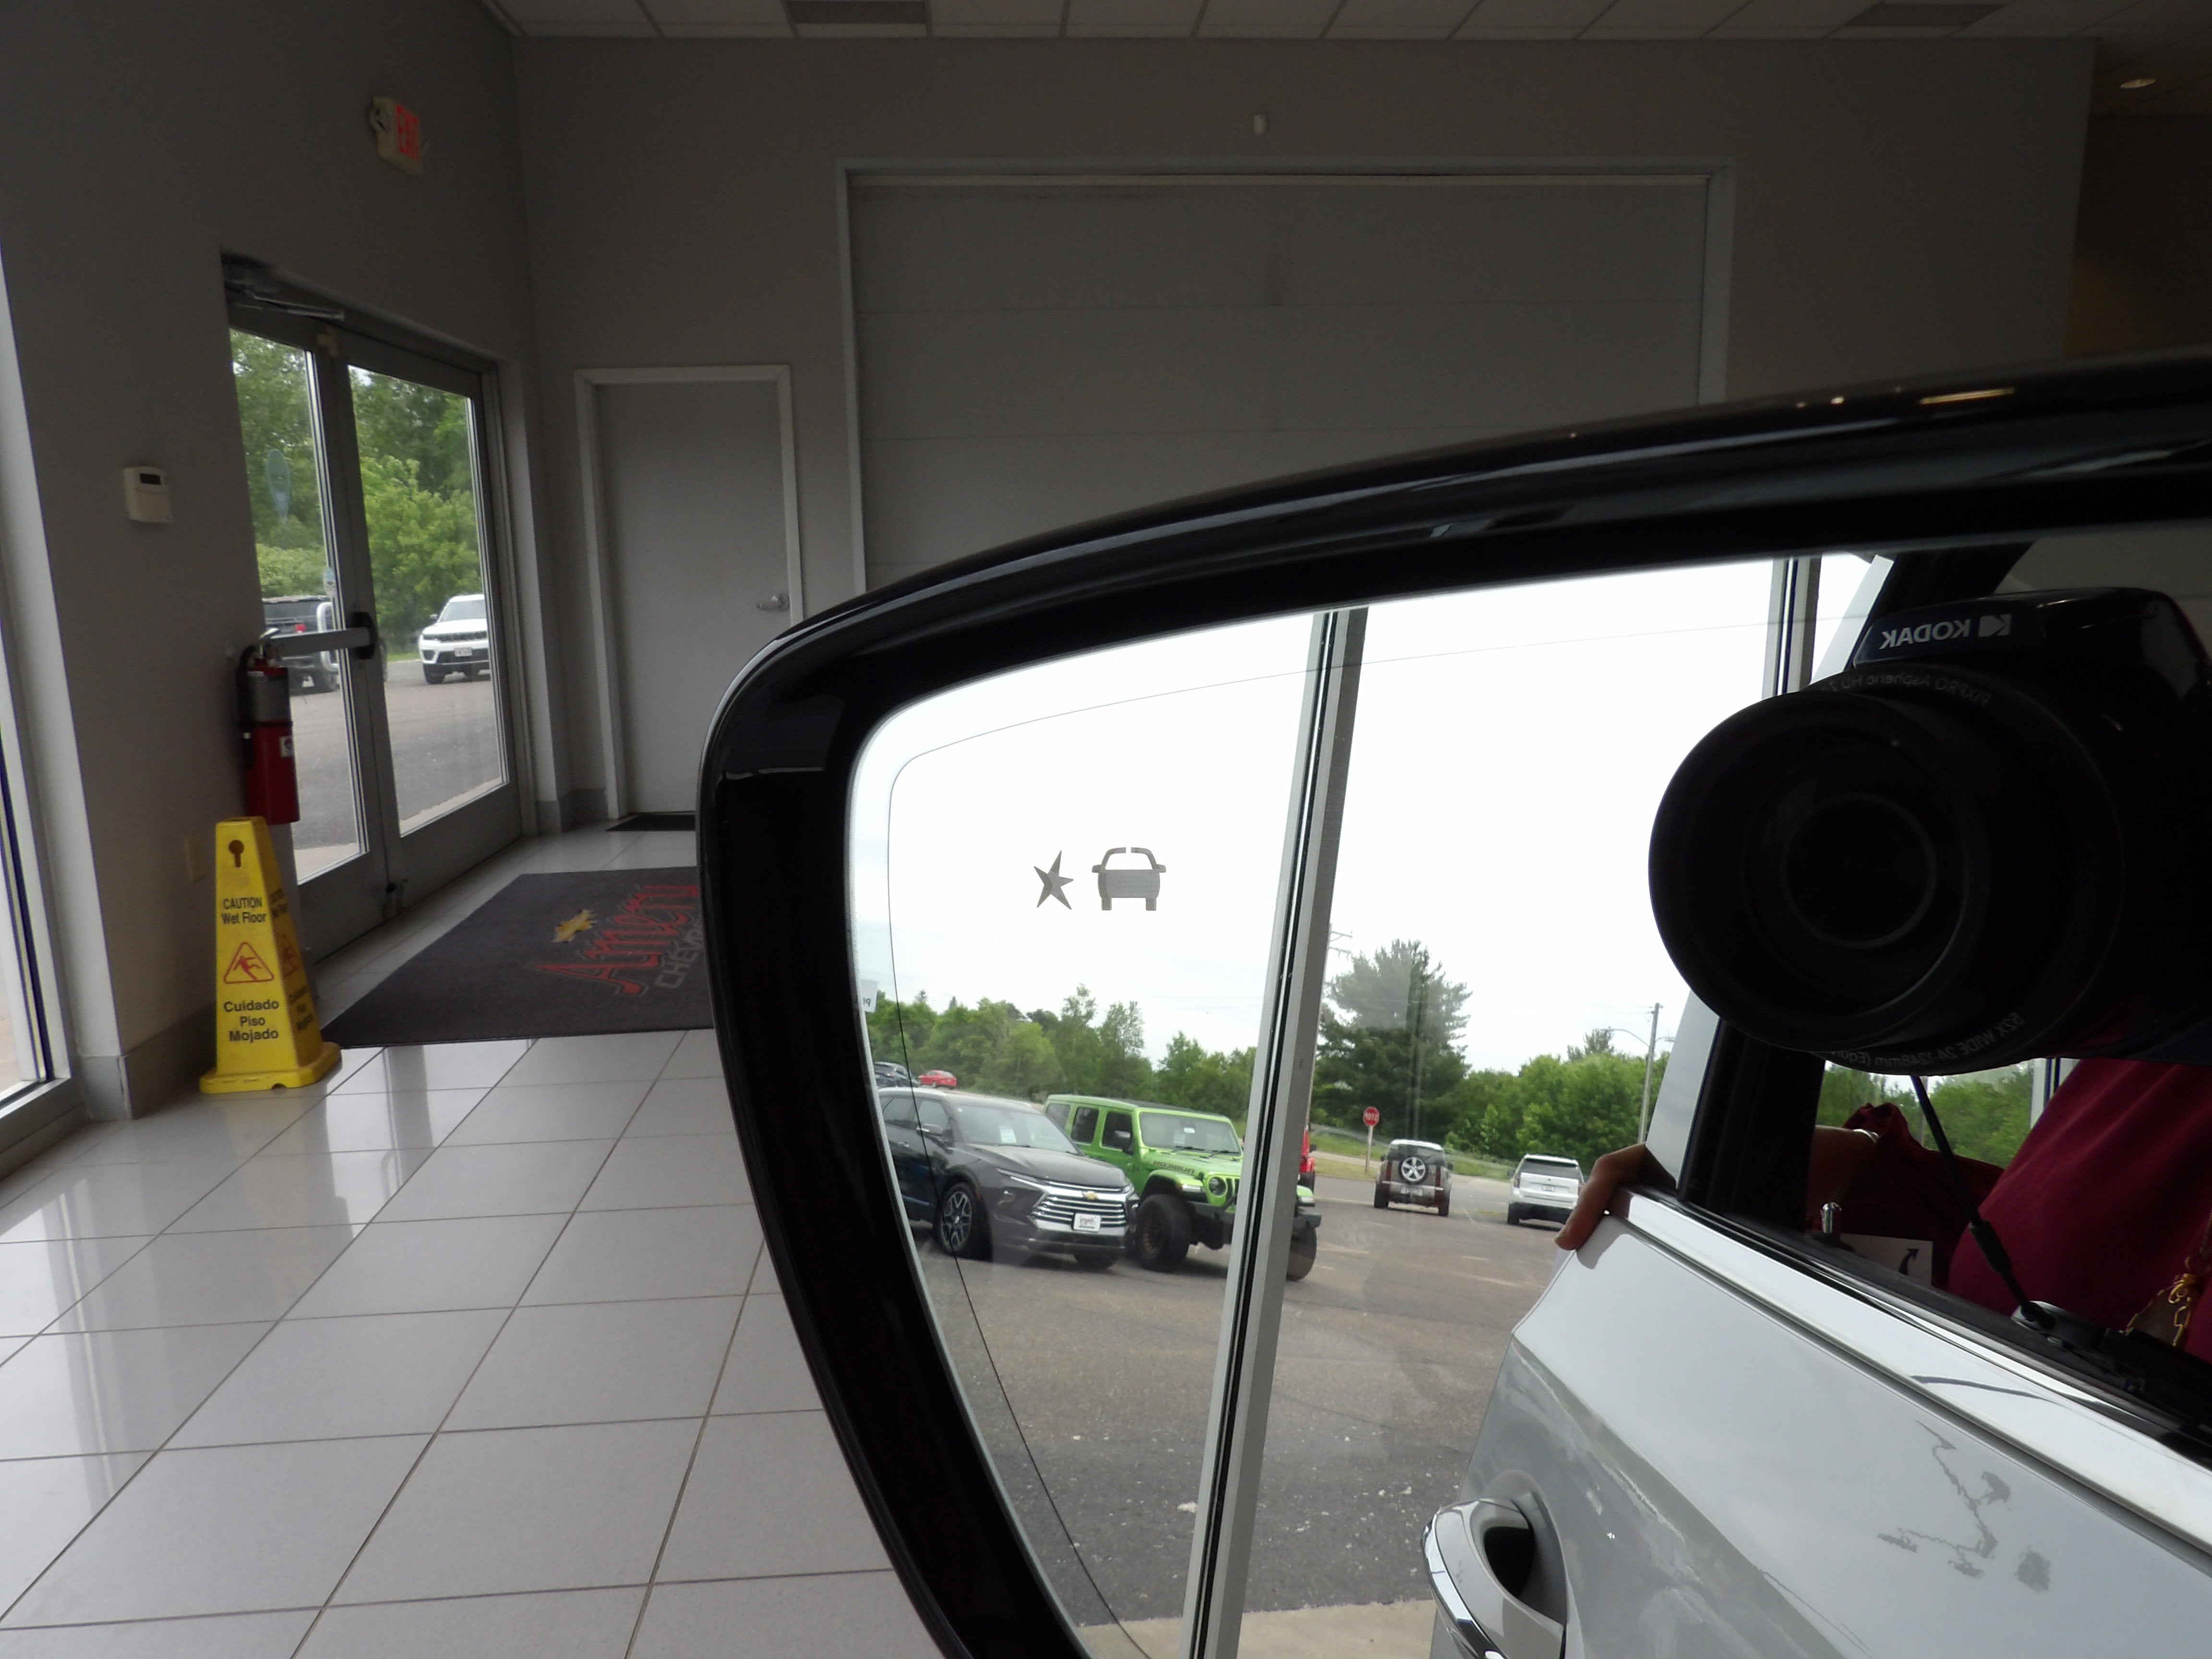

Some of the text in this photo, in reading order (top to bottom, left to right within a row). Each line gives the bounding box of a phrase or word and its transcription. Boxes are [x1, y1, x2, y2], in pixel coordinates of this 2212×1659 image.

[223, 897, 262, 910] CAUTION
[221, 911, 266, 925] Wet Floor
[224, 999, 279, 1012] Cuidado
[240, 1015, 265, 1027] Piso
[229, 1028, 279, 1044] Mojado
